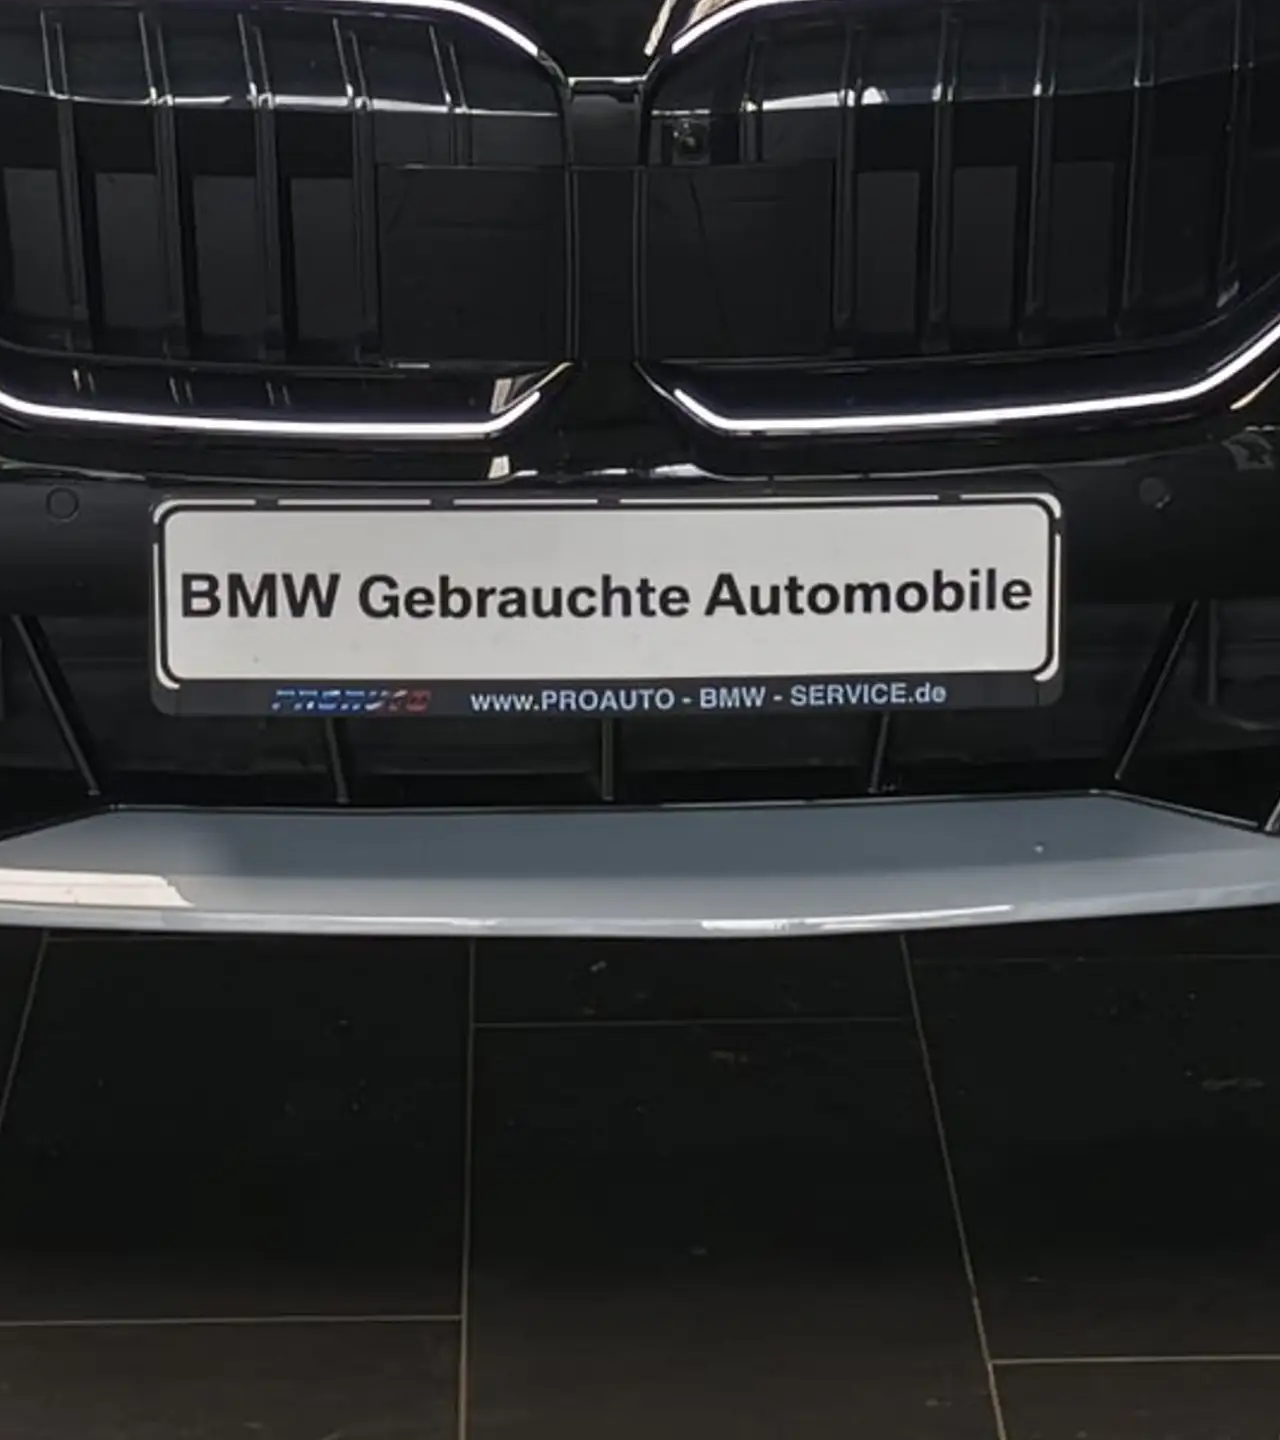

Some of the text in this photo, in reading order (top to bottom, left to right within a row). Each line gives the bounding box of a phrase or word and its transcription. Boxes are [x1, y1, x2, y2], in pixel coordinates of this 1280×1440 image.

[181, 568, 1033, 618] BMW Gebrauchte Automobile
